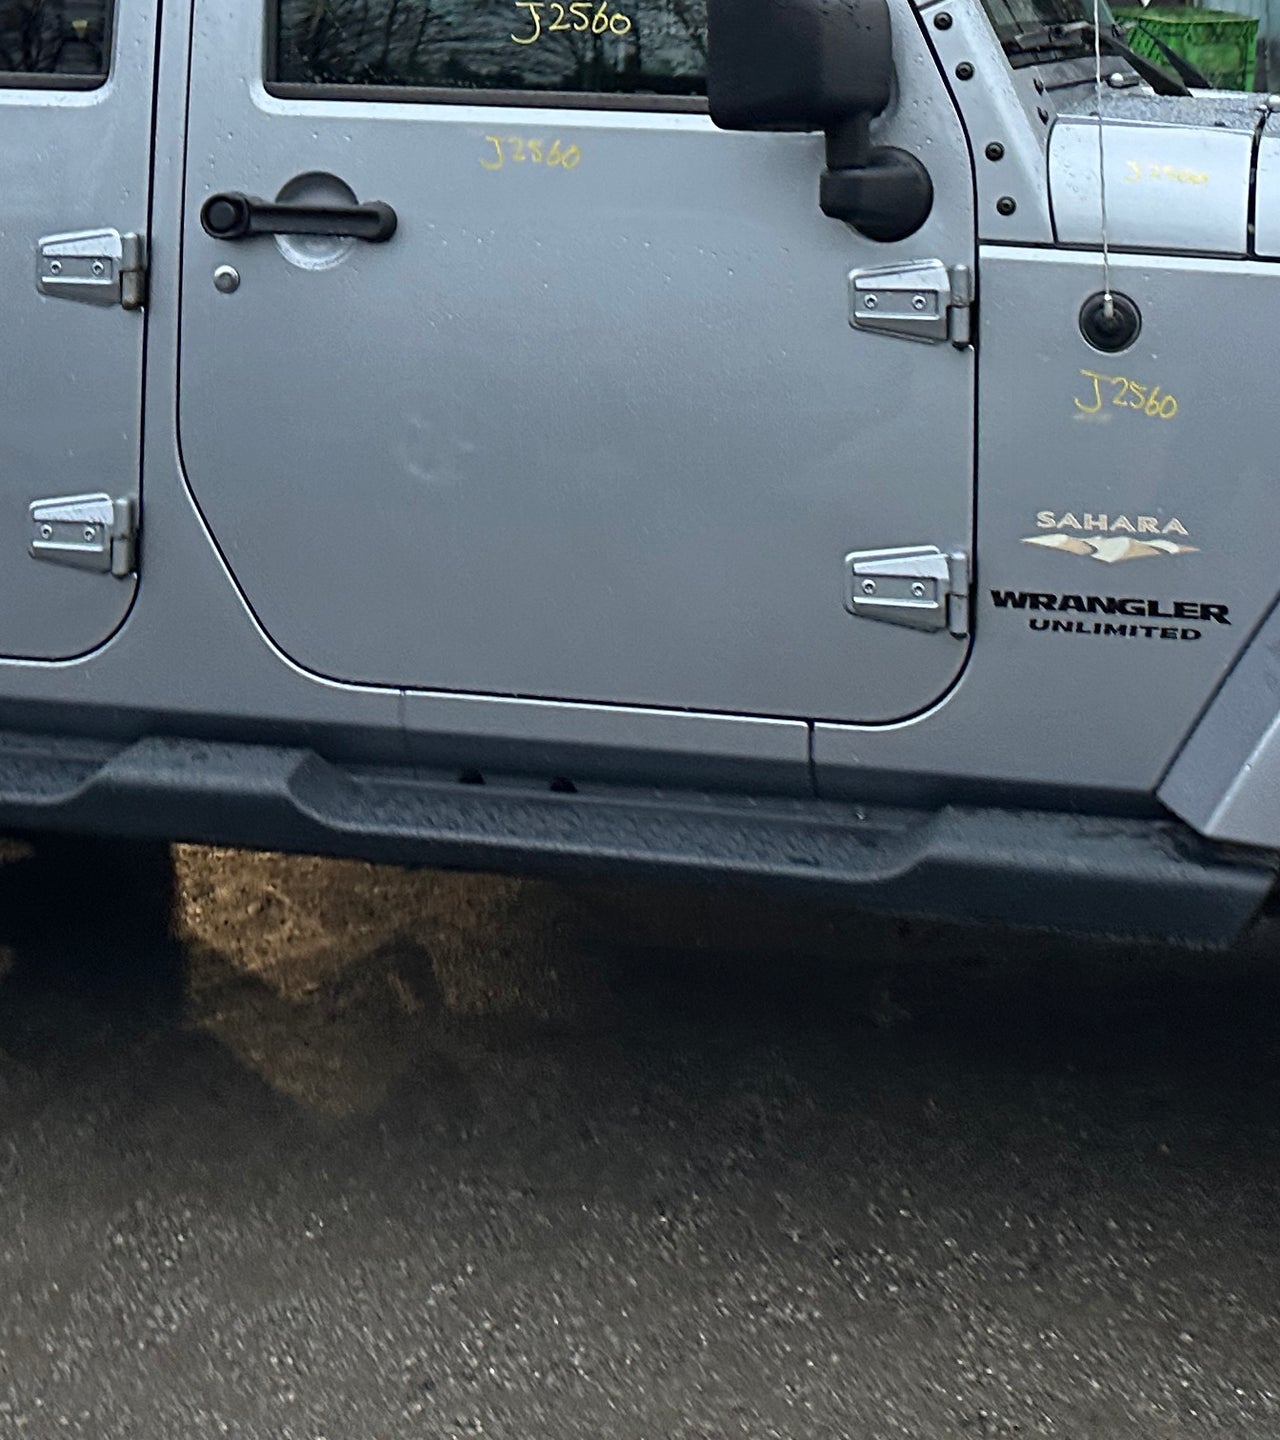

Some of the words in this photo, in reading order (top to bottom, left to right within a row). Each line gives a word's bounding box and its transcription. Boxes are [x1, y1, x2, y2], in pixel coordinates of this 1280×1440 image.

[511, 1, 632, 45] J2560
[480, 135, 581, 171] J2560
[1074, 368, 1179, 418] J2560
[1036, 510, 1190, 536] SAHARA
[990, 588, 1232, 625] WRANGLER
[1028, 618, 1202, 641] UNLIMITED
